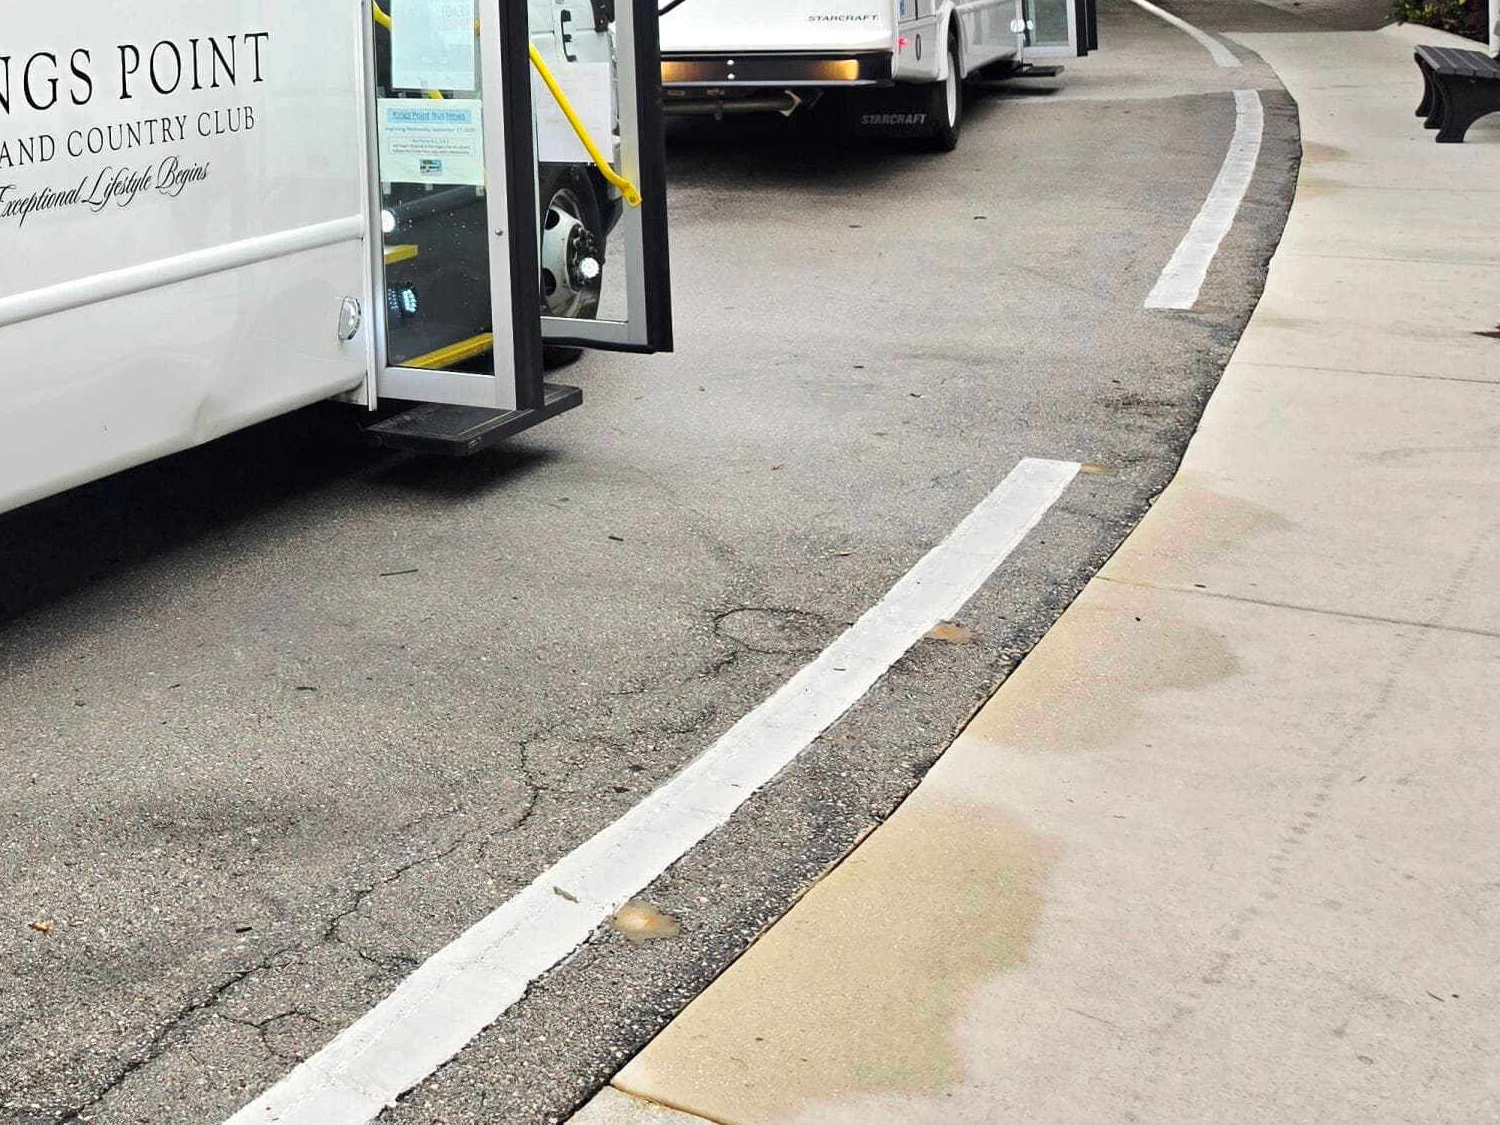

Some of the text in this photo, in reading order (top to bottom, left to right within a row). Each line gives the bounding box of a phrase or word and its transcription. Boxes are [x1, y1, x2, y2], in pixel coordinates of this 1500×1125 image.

[808, 14, 878, 22] STARCRAFT
[117, 32, 269, 100] POINT
[67, 115, 188, 157] COUNTRY
[197, 106, 255, 137] CLUB
[861, 113, 927, 125] STARCRAFT
[81, 166, 152, 212] Lifestyle
[155, 155, 210, 197] Begins
